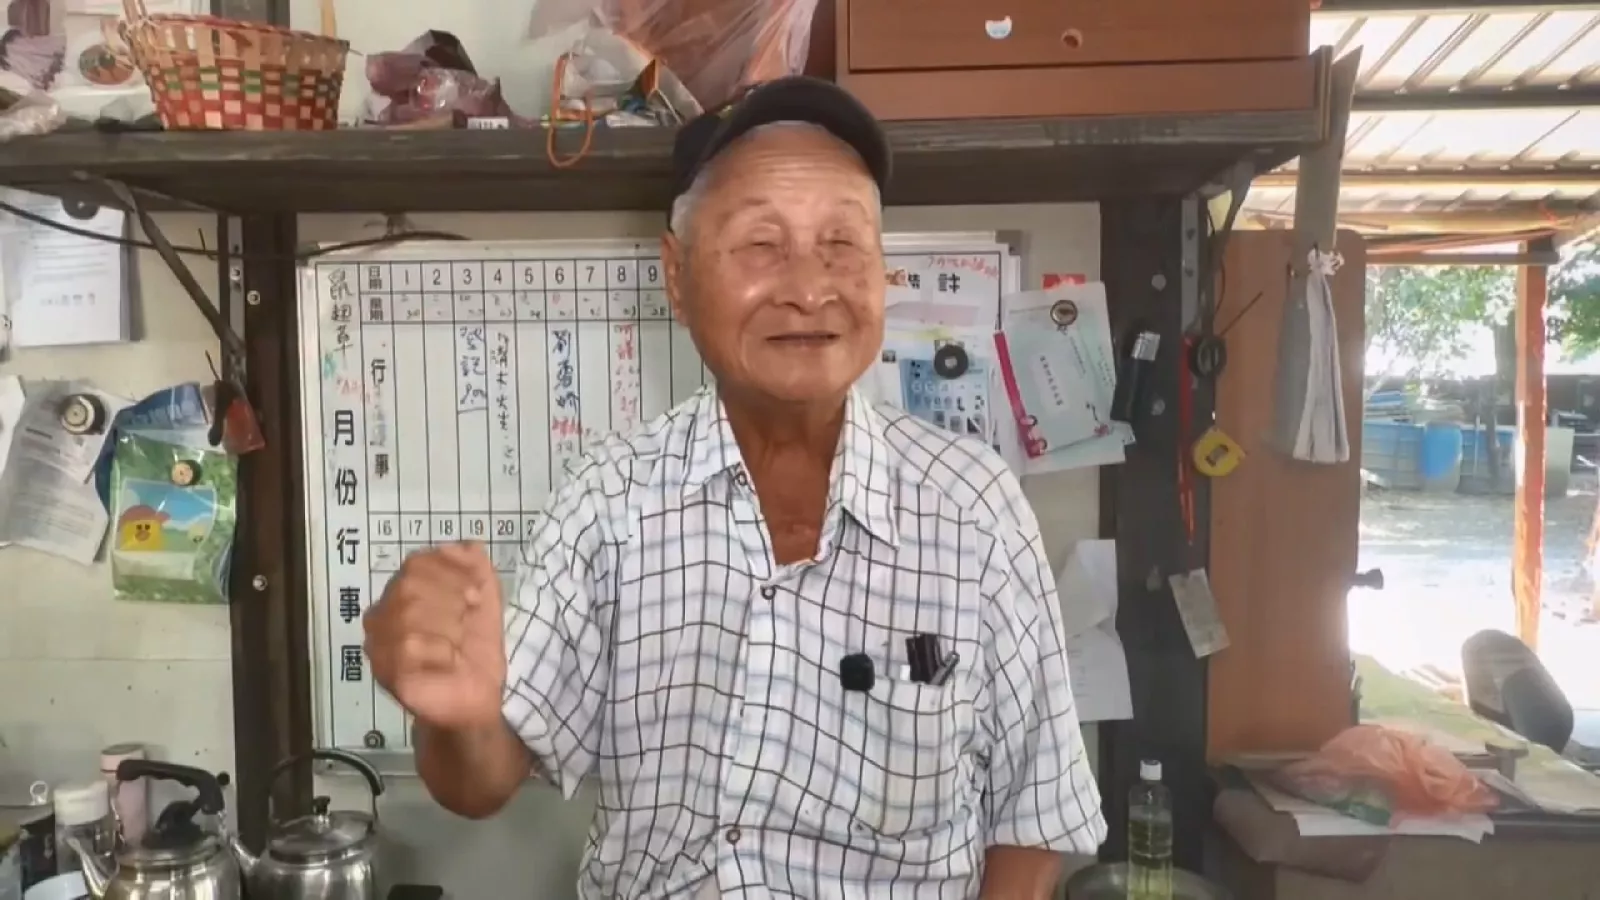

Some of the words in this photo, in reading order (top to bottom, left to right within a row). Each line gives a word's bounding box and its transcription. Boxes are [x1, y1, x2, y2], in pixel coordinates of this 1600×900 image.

[404, 269, 409, 285] 1
[432, 268, 441, 285] 2
[463, 268, 472, 285] 3
[494, 269, 502, 284] 4
[524, 267, 534, 284] 5
[555, 266, 565, 284] 6
[586, 266, 595, 283] 7
[617, 265, 626, 282] 8
[648, 265, 658, 282] 9
[377, 519, 392, 536] 16
[409, 519, 423, 536] 17
[439, 519, 453, 536] 18
[469, 519, 484, 536] 19
[497, 519, 514, 536] 20
[333, 410, 363, 681] 月份行事曆
